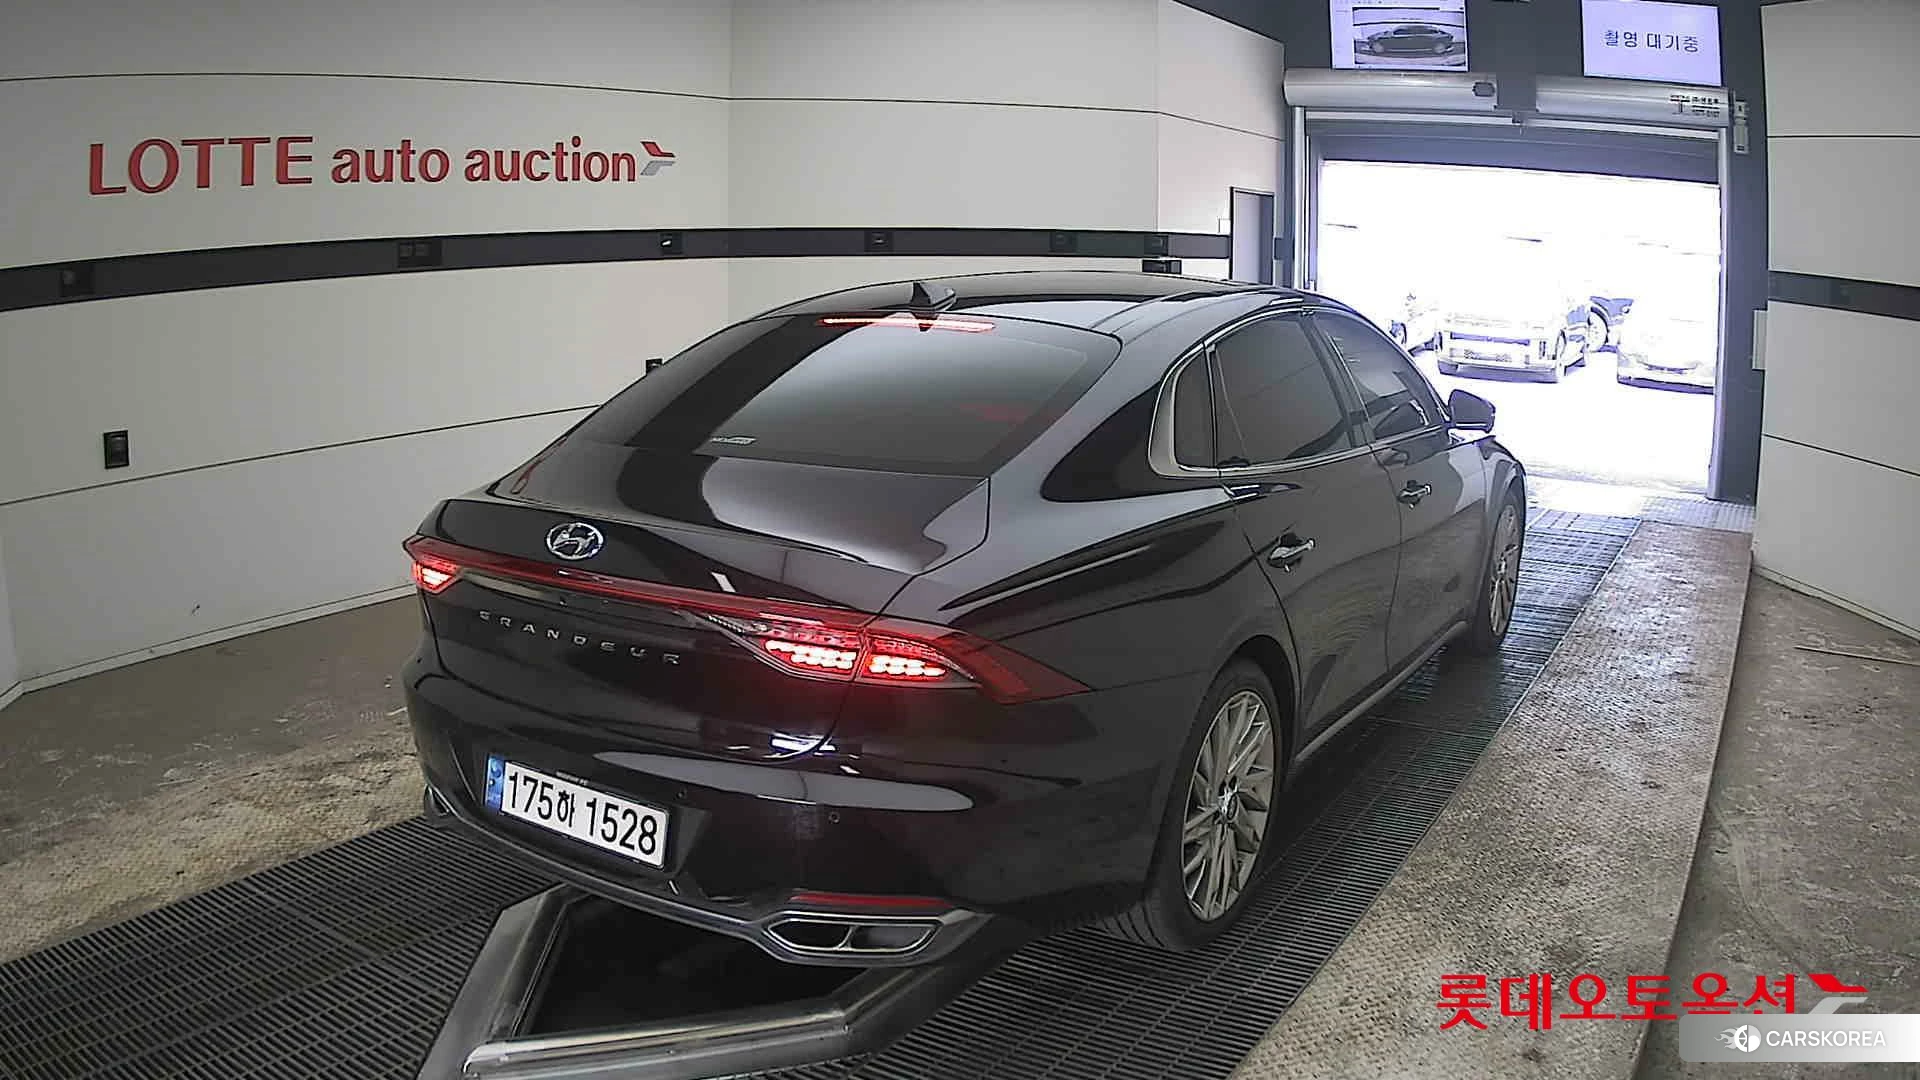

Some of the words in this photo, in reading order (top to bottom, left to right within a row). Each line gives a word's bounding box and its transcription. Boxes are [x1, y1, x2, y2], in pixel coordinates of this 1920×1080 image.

[1646, 32, 1699, 53] 대기중
[89, 136, 314, 196] LOTTE
[331, 139, 450, 183] auto
[464, 136, 636, 182] auction
[479, 610, 681, 665] GRANDEUR
[508, 771, 576, 828] 175하
[586, 797, 658, 856] 1528
